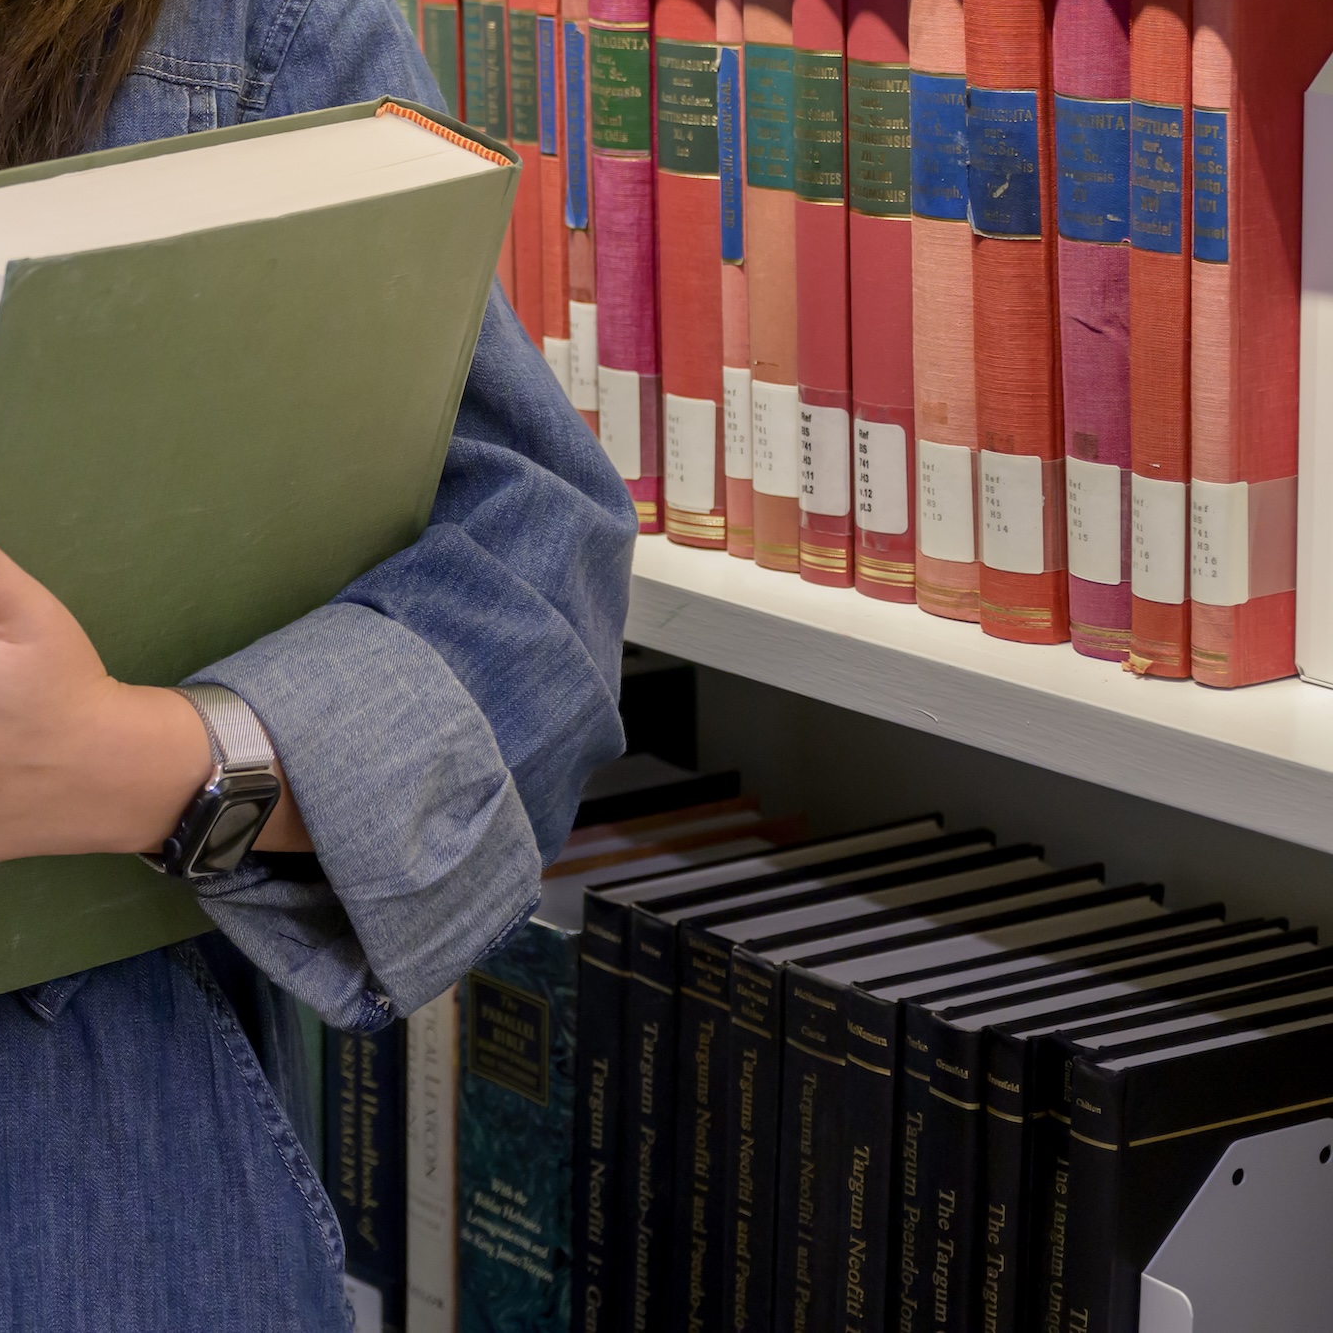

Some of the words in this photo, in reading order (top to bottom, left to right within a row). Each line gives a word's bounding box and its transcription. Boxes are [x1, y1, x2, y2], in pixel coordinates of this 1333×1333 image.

[801, 411, 812, 423] Ref
[801, 426, 810, 437] BS
[858, 429, 869, 441] Ref
[801, 440, 812, 452] 741
[859, 443, 868, 454] BS
[859, 457, 870, 469] 741
[802, 470, 814, 481] v.11
[859, 488, 873, 499] v.12
[985, 496, 1000, 507] 741
[859, 501, 872, 513] pt.3
[639, 1022, 659, 1115] Targum
[695, 1020, 715, 1105] Targums
[739, 1048, 759, 1131] Targums
[423, 1073, 442, 1182] LEXICON
[588, 1057, 609, 1150] Targum
[798, 1072, 818, 1155] Targums
[693, 1107, 712, 1179] Neofiti
[737, 1134, 756, 1205] Neofiti
[903, 1110, 924, 1197] Targum
[587, 1159, 607, 1246] Neofiti
[692, 1195, 707, 1234] and
[798, 1157, 815, 1228] Neofiti
[848, 1145, 870, 1231] Targum
[938, 1189, 956, 1231] The
[736, 1220, 752, 1260] and
[987, 1203, 1006, 1246] The
[796, 1244, 811, 1284] and
[845, 1233, 867, 1320] Neofiti
[932, 1238, 954, 1323] Targum
[983, 1253, 1004, 1333] Targum
